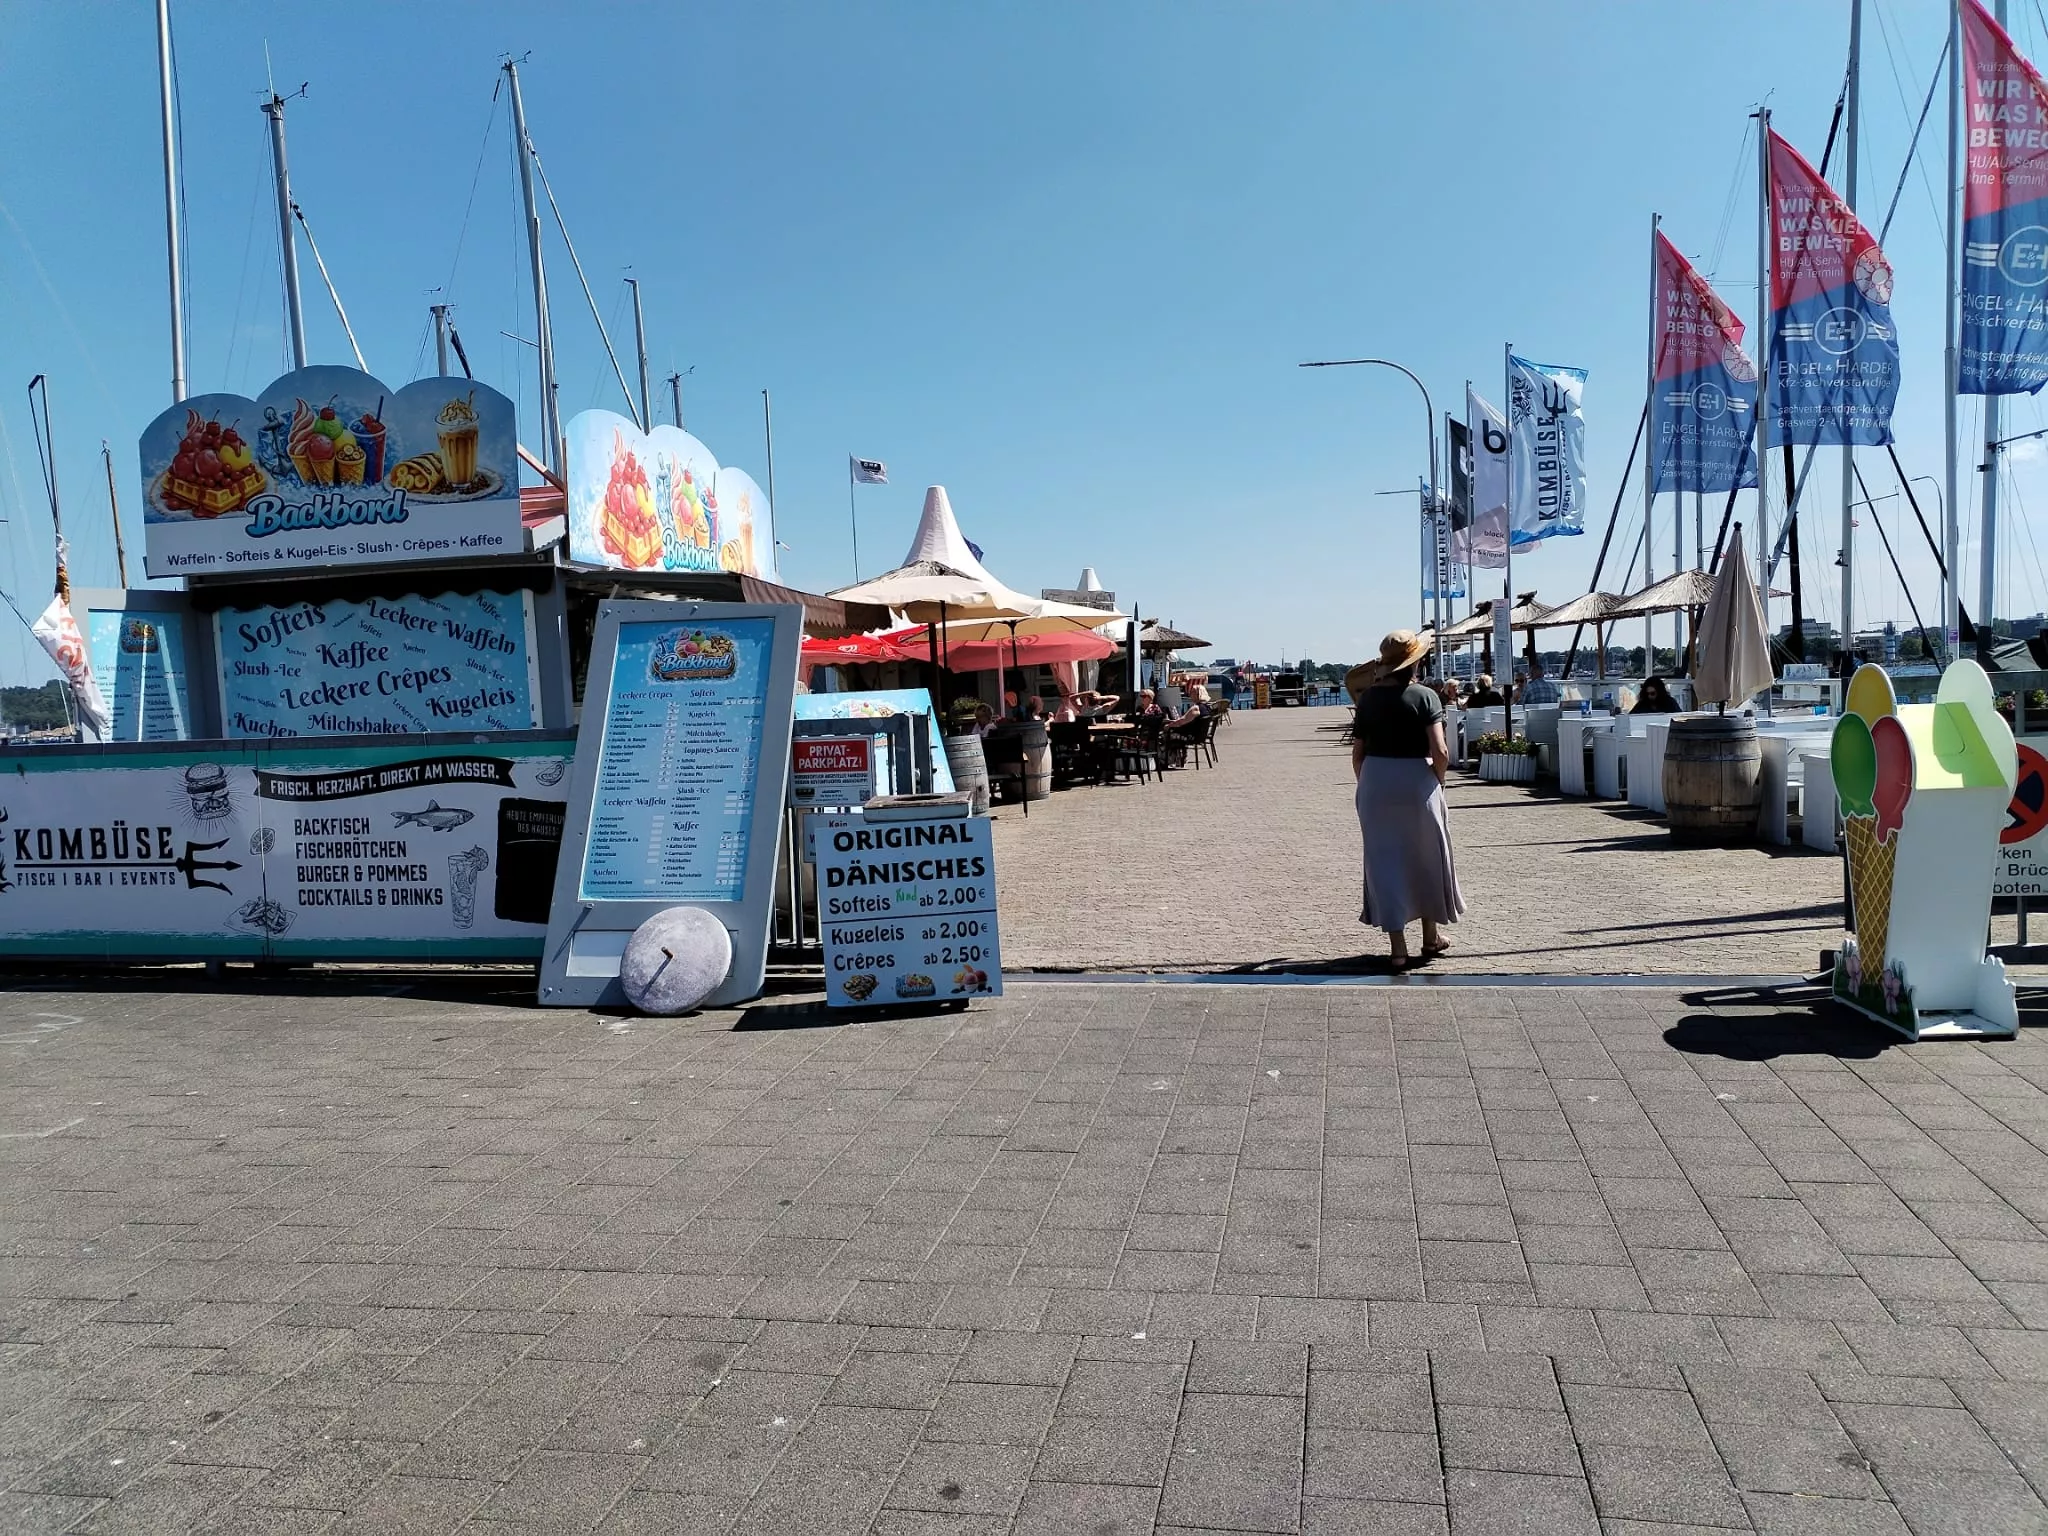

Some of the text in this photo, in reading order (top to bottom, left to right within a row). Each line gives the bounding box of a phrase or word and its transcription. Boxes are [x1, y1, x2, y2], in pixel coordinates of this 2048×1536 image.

[1977, 80, 2022, 98] WIR
[1974, 103, 2028, 123] WAS
[1780, 198, 1816, 213] WIR
[1780, 215, 1866, 235] WAS KIEL
[1667, 290, 1692, 305] WIR
[1667, 305, 1696, 319] WAS
[1779, 361, 1824, 375] ENGEL
[1836, 359, 1893, 374] HARDER
[1534, 417, 1558, 521] KOMBÜSE
[245, 487, 409, 538] Backbord
[167, 534, 503, 566] Waffeln Softeis & Kugel-Eis Slush Crêpes Kaffee
[476, 594, 501, 620] Kaffee
[238, 604, 326, 652] Softeis
[366, 600, 516, 656] Leckere Waffeln
[315, 641, 389, 669] Kaffee
[661, 652, 731, 672] Backbord
[234, 661, 269, 676] Slush
[280, 666, 452, 710] Leckere Crêpes
[690, 689, 715, 698] Softeis
[425, 687, 516, 718] Kugeleis
[234, 712, 408, 737] Kuchen Milchshakes
[809, 745, 851, 757] PRIVAT-
[799, 757, 862, 769] PARKPLATZ!
[270, 762, 499, 797] FRISCH. HERZHAFT. DIREKT AM WASSER.
[603, 798, 633, 807] Leckere
[635, 797, 666, 807] Waffeln
[294, 817, 370, 836] BACKFISCH
[672, 821, 699, 831] Kaffee
[14, 820, 174, 860] KOMBÜSE
[833, 822, 974, 851] ORIGINAL
[295, 837, 407, 860] FISCHBRÖTCHEN
[17, 872, 55, 886] FISCH
[75, 872, 102, 886] BAR
[122, 871, 176, 886] EVENTS
[297, 864, 427, 882] BURGER & POMMES
[593, 869, 617, 877] Kuchen
[826, 857, 986, 888] DÄNISCHES
[298, 887, 443, 906] COCKTAILS & DRINKS
[1993, 882, 2041, 894] boten
[829, 894, 891, 914] Softeis
[919, 894, 934, 907] ab
[831, 924, 905, 945] Kugeleis
[922, 928, 936, 940] ab
[834, 952, 896, 971] Crêpes
[924, 953, 938, 965] ab
